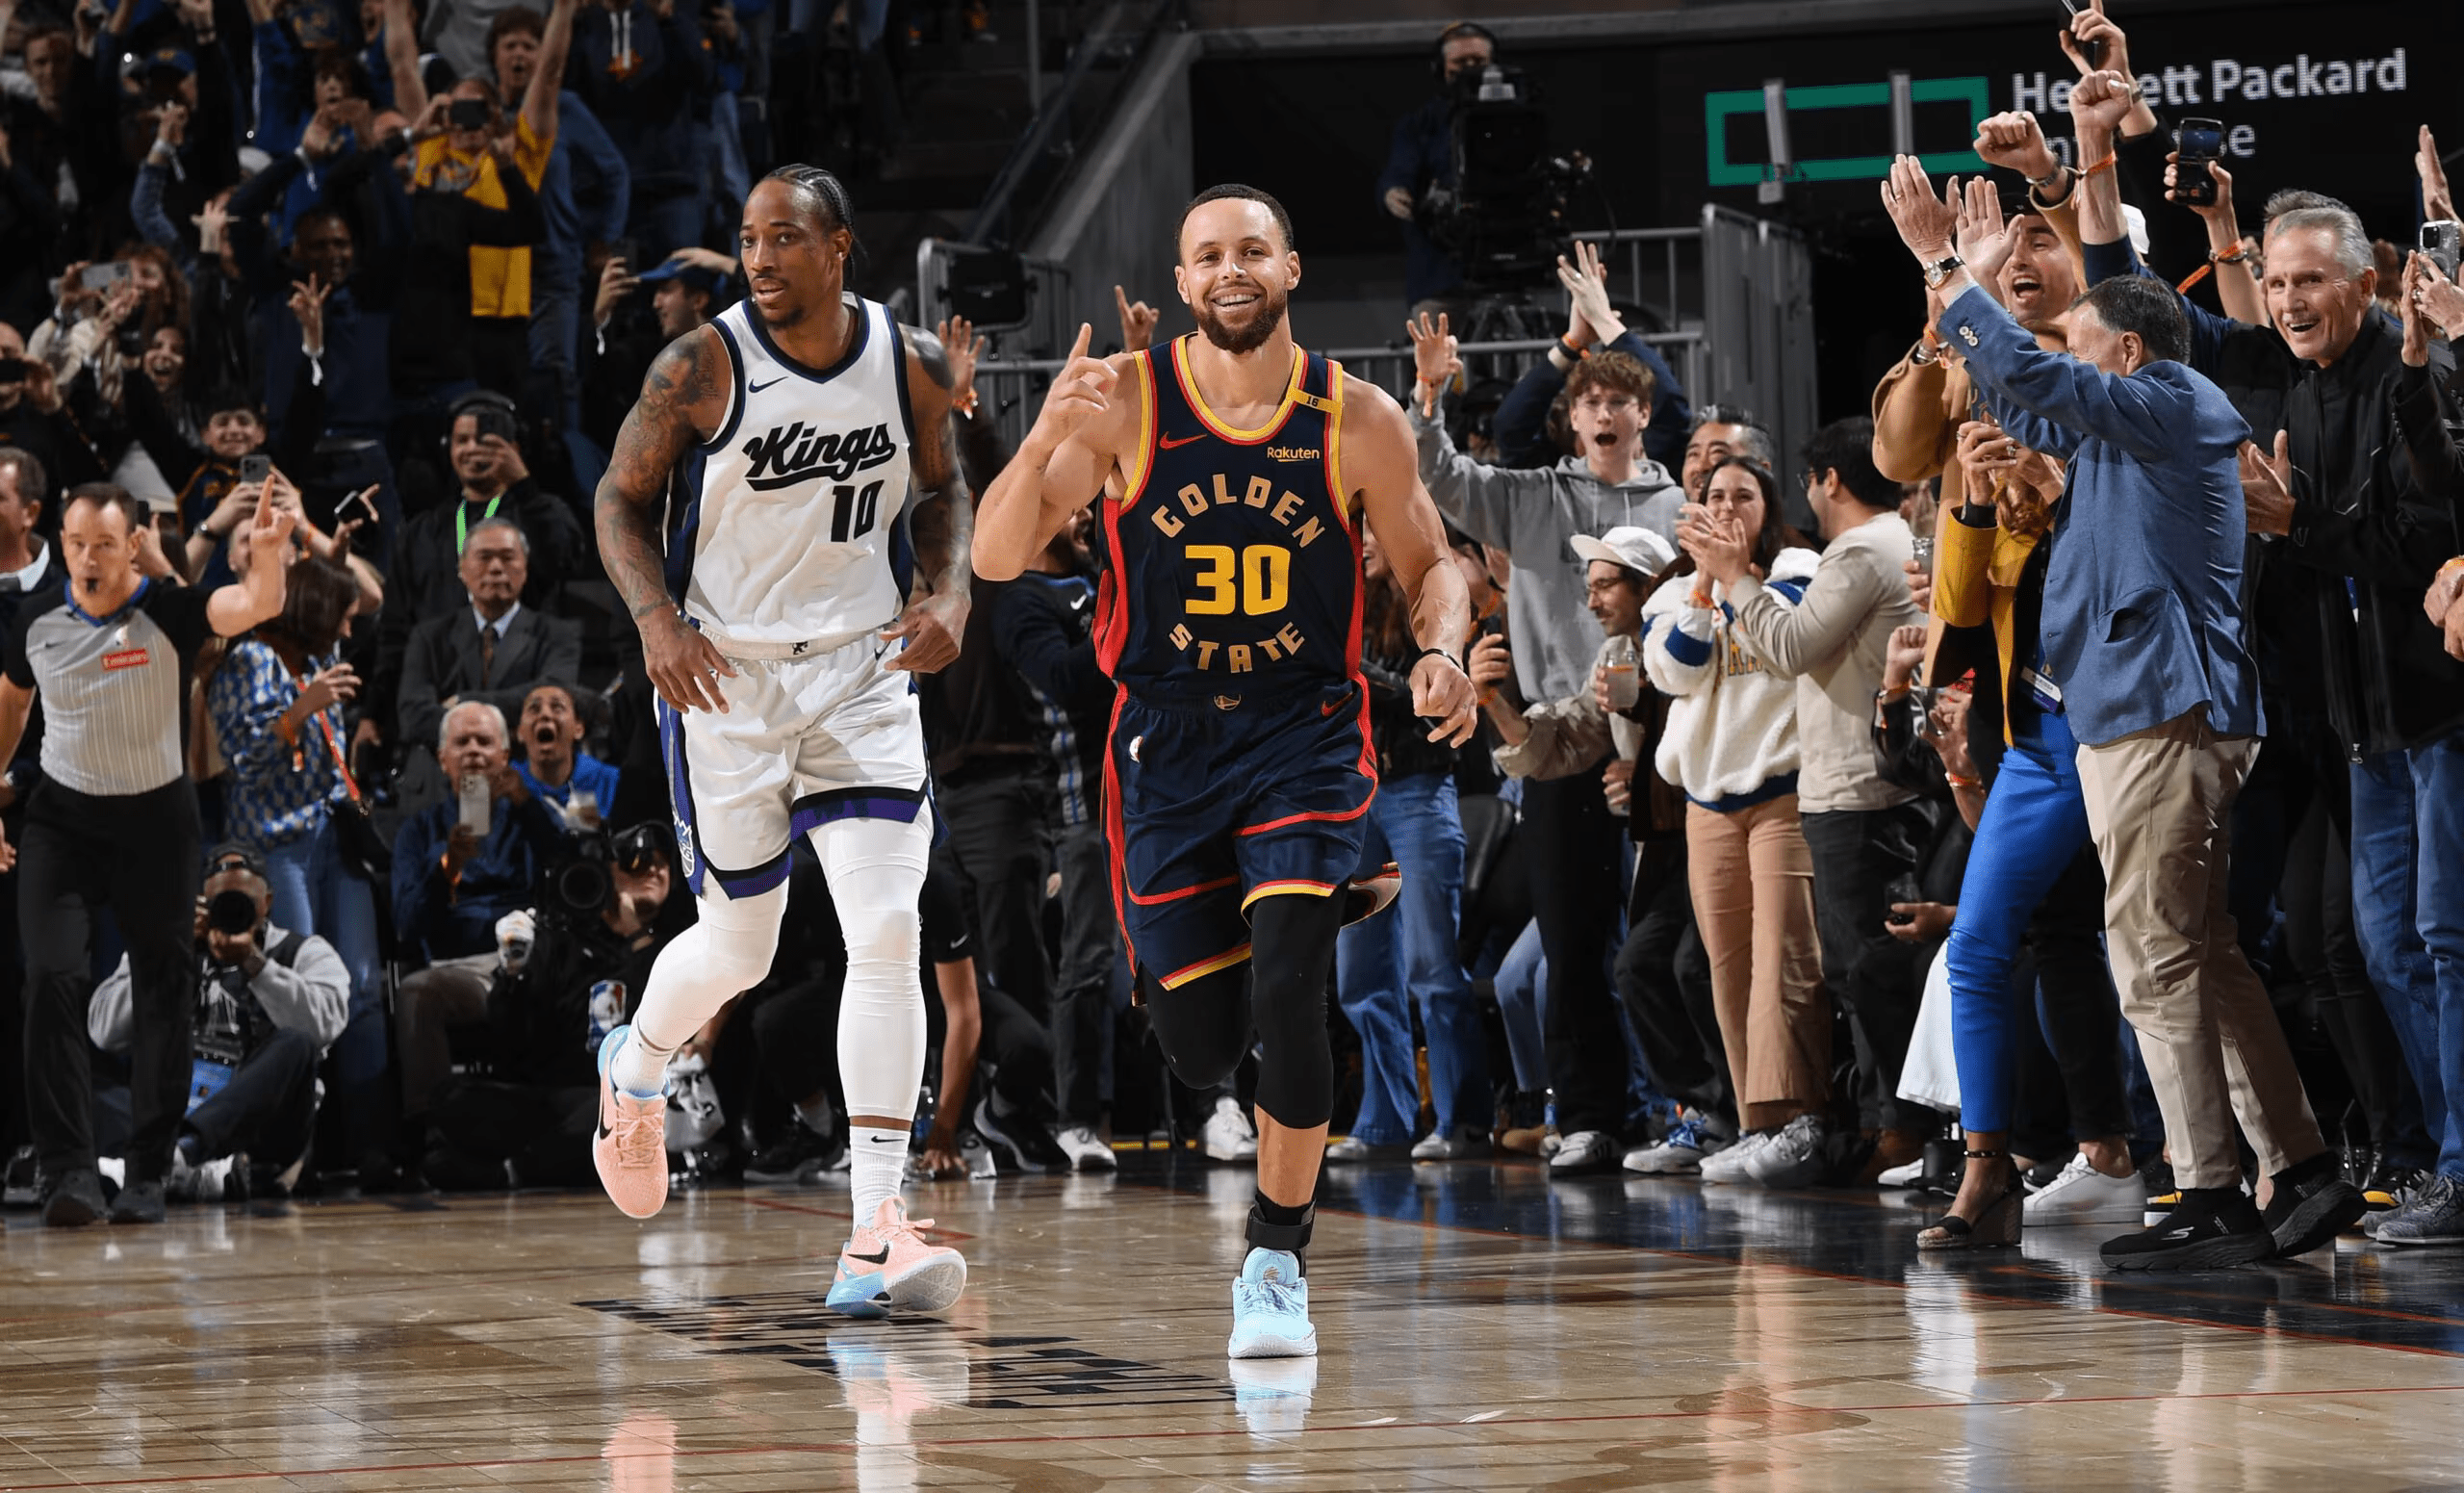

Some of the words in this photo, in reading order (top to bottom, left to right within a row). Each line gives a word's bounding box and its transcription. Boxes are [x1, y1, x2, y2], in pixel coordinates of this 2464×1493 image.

[2013, 64, 2201, 115] Heett
[2213, 48, 2406, 101] Packard
[1306, 396, 1320, 407] 16
[742, 421, 896, 492] Kings
[1267, 446, 1321, 460] Rakuten
[831, 479, 885, 543] 10
[1150, 473, 1326, 549] GOLDEN
[1185, 544, 1291, 616] 30
[1168, 621, 1305, 674] STATE
